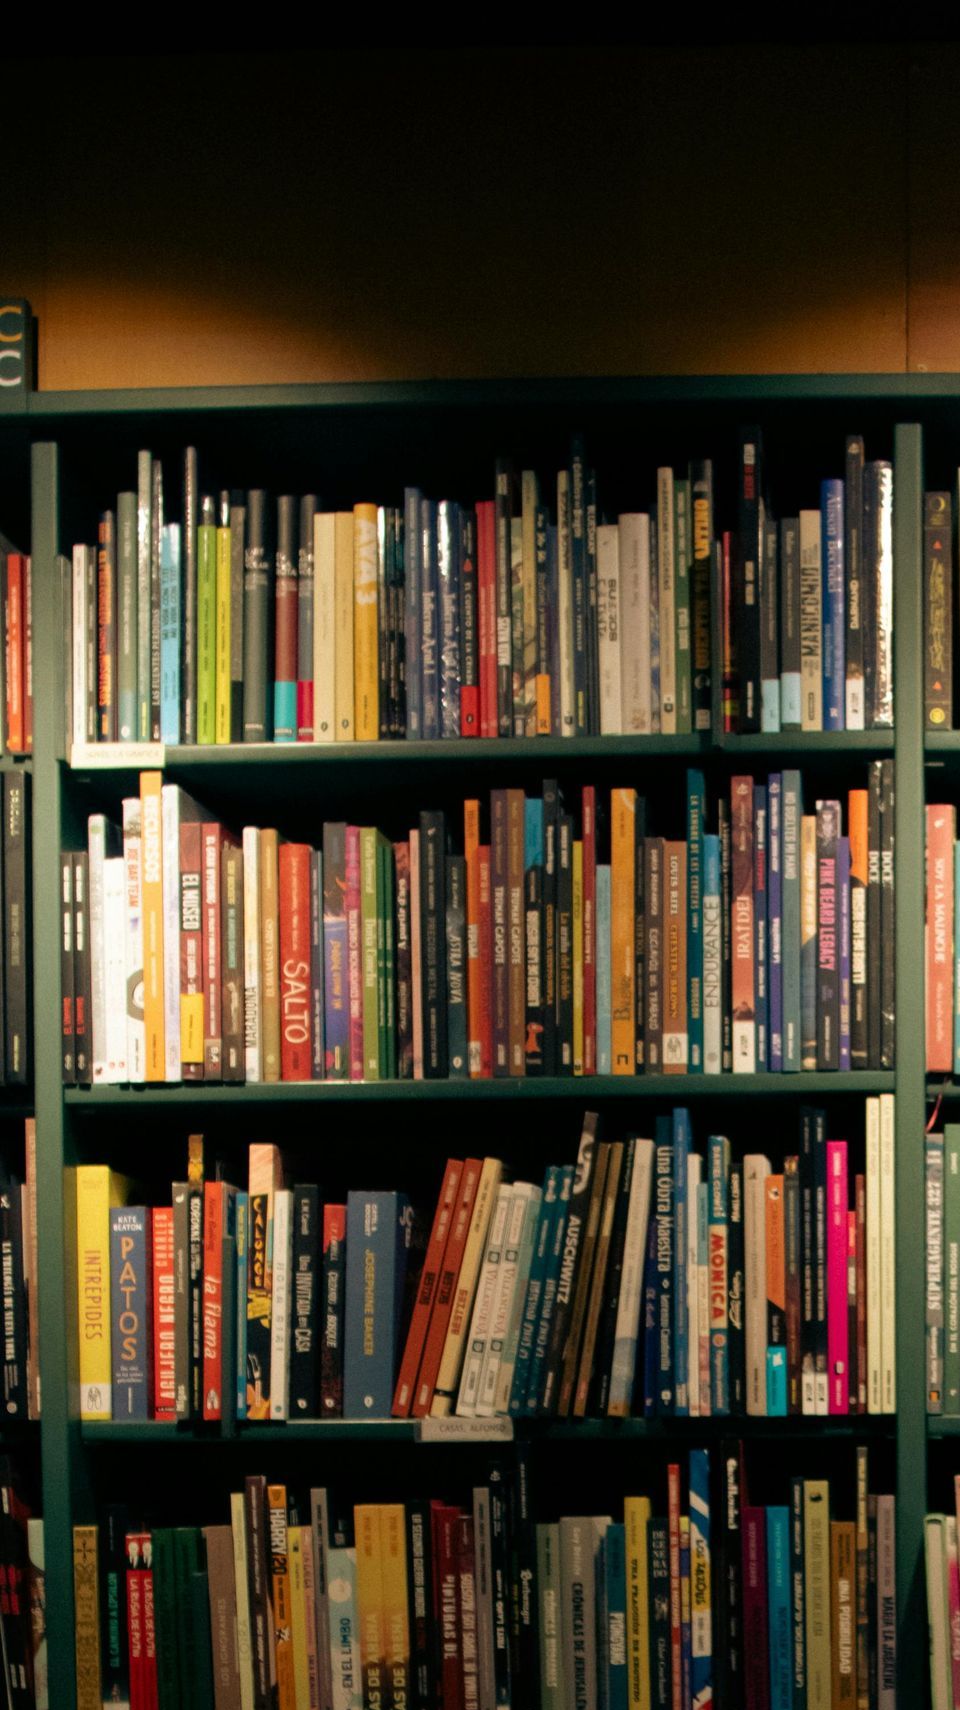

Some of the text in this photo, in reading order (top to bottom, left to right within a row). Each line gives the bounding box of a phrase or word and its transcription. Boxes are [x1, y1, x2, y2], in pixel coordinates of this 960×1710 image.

[826, 492, 840, 535] Alison
[828, 541, 842, 593] Bechdel
[802, 568, 819, 656] MANICOMIO
[144, 794, 159, 882] RECURSOS
[869, 851, 879, 883] DOCE
[882, 851, 892, 883] DOCE
[182, 874, 200, 930] EL MUSEO
[494, 887, 505, 964] TRUMAN CAPOTE
[511, 887, 522, 964] TRUMAN CAPOTE
[669, 856, 679, 1018] LOUIS RIEL CHESTER BROWN
[819, 858, 835, 971] PINK BEARD LEGACY
[934, 858, 945, 964] SOY LA MALINCHE
[449, 935, 463, 1004] ASTRA NOVA
[705, 902, 719, 1008] ENDURANCE
[245, 986, 258, 1048] MARADONA
[283, 960, 309, 1044] SALTO
[656, 1146, 672, 1272] Una Obra Maestra
[928, 1180, 941, 1310] SUPERAGENTE 327
[119, 1235, 139, 1361] PATOS
[558, 1215, 580, 1304] AUSCHWITZ
[712, 1234, 726, 1319] MONICA
[204, 1275, 220, 1359] la flama
[364, 1249, 374, 1355] JOSEPHINE BAKER
[270, 1508, 287, 1575] HARRY 20
[572, 1583, 587, 1636] CRÓNICAS
[839, 1580, 850, 1601] UNA
[340, 1618, 352, 1688] EN EL LIMBO
[368, 1667, 379, 1687] DE
[394, 1667, 405, 1687] DE
[574, 1641, 586, 1653] DE
[632, 1640, 640, 1653] DE
